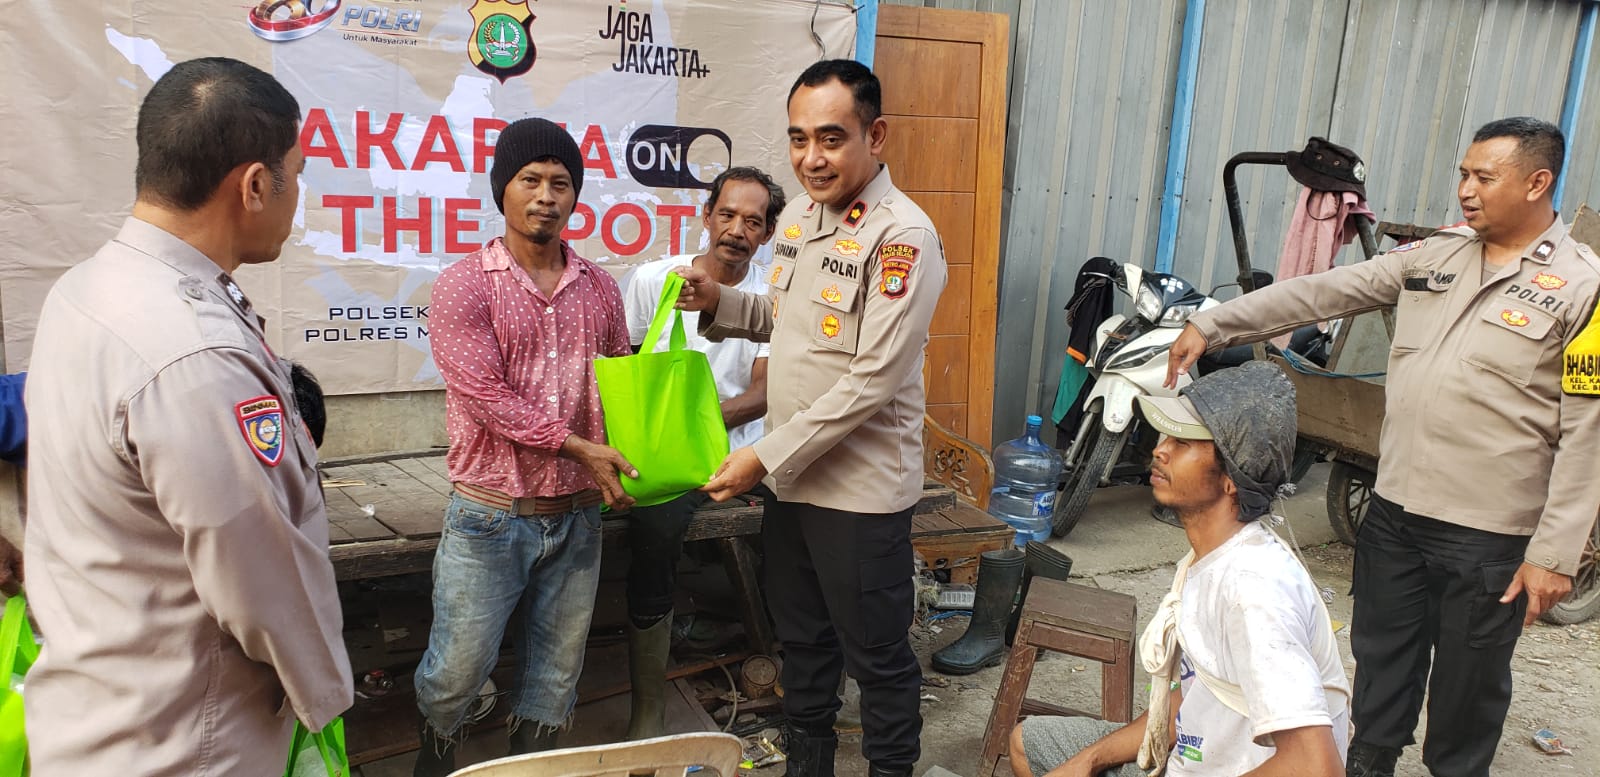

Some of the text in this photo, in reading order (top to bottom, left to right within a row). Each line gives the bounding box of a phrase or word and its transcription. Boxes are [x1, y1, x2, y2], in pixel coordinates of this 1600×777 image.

[341, 5, 422, 32] POLRI
[599, 5, 653, 43] JAGA
[343, 33, 417, 46] Untuk Masyarakat
[632, 141, 682, 171] ON
[322, 195, 697, 256] THE POT
[882, 246, 914, 255] POLSEK
[821, 256, 858, 279] POLRI
[1505, 284, 1564, 313] POLRI
[328, 306, 430, 321] POLSEK
[305, 327, 408, 342] POLRES
[1566, 354, 1600, 377] BHABI
